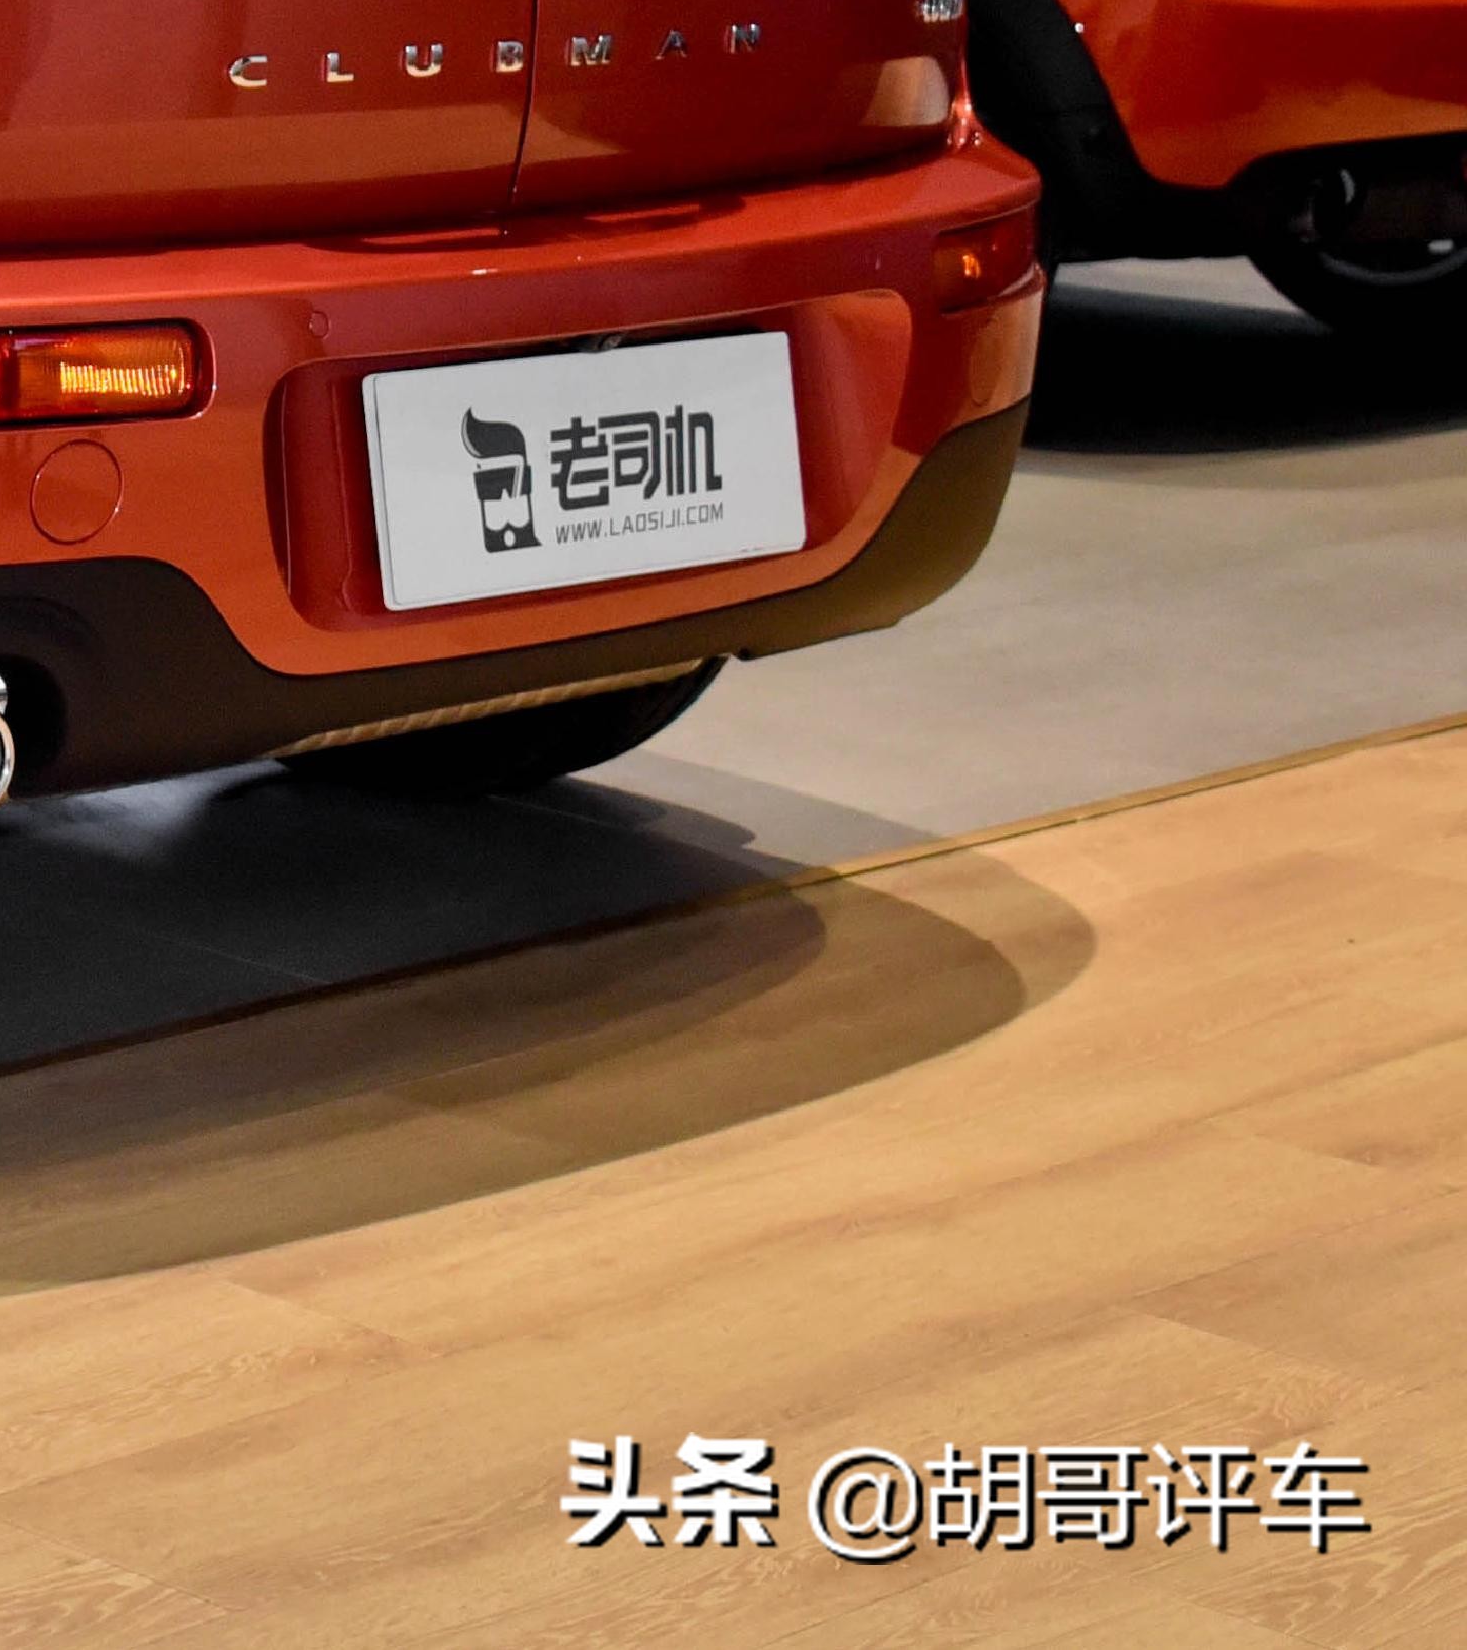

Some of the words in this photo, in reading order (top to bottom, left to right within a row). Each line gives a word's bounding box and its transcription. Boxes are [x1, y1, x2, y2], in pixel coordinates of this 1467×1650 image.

[228, 22, 761, 89] CLUBMAN
[550, 404, 723, 511] 老司机
[555, 501, 724, 545] WWW.LAOSIJI.COM
